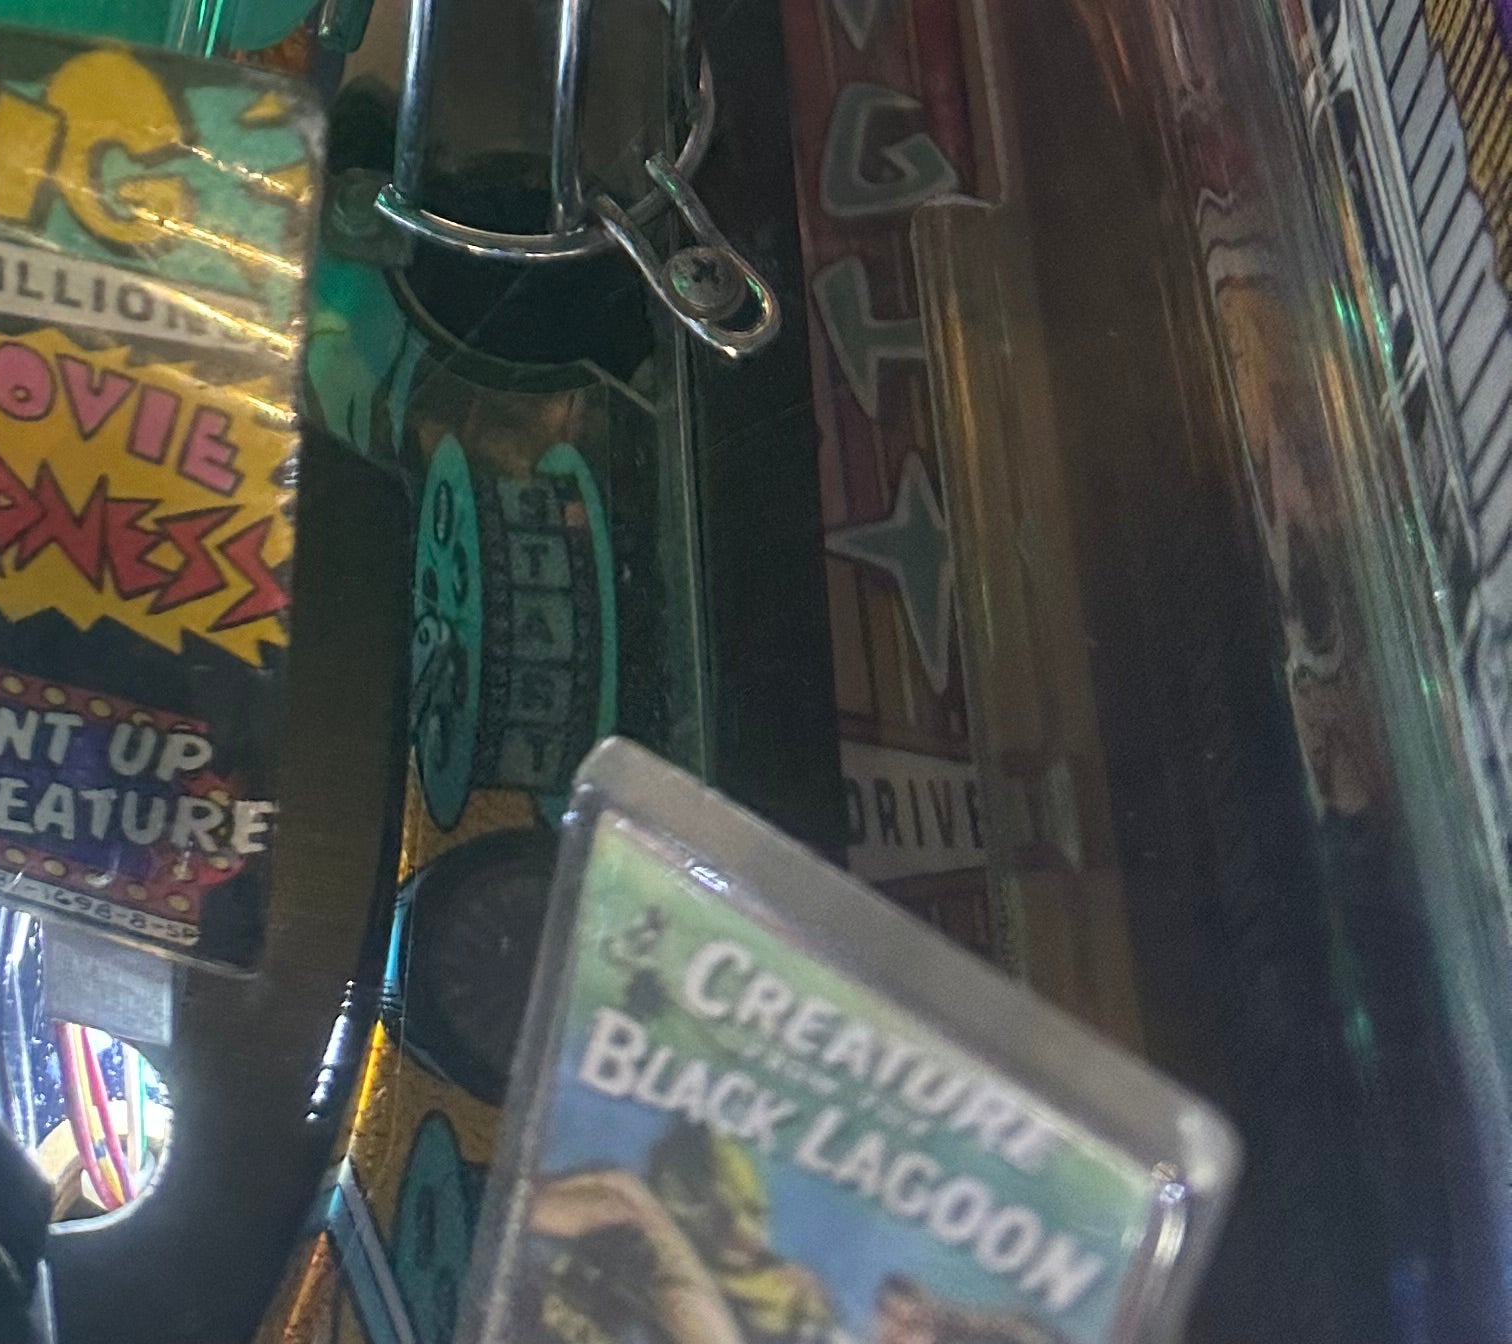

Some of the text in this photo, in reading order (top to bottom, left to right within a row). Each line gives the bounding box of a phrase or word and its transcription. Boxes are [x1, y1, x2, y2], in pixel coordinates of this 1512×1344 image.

[110, 721, 214, 783] UP
[578, 1008, 1108, 1312] BLACK LAGOON
